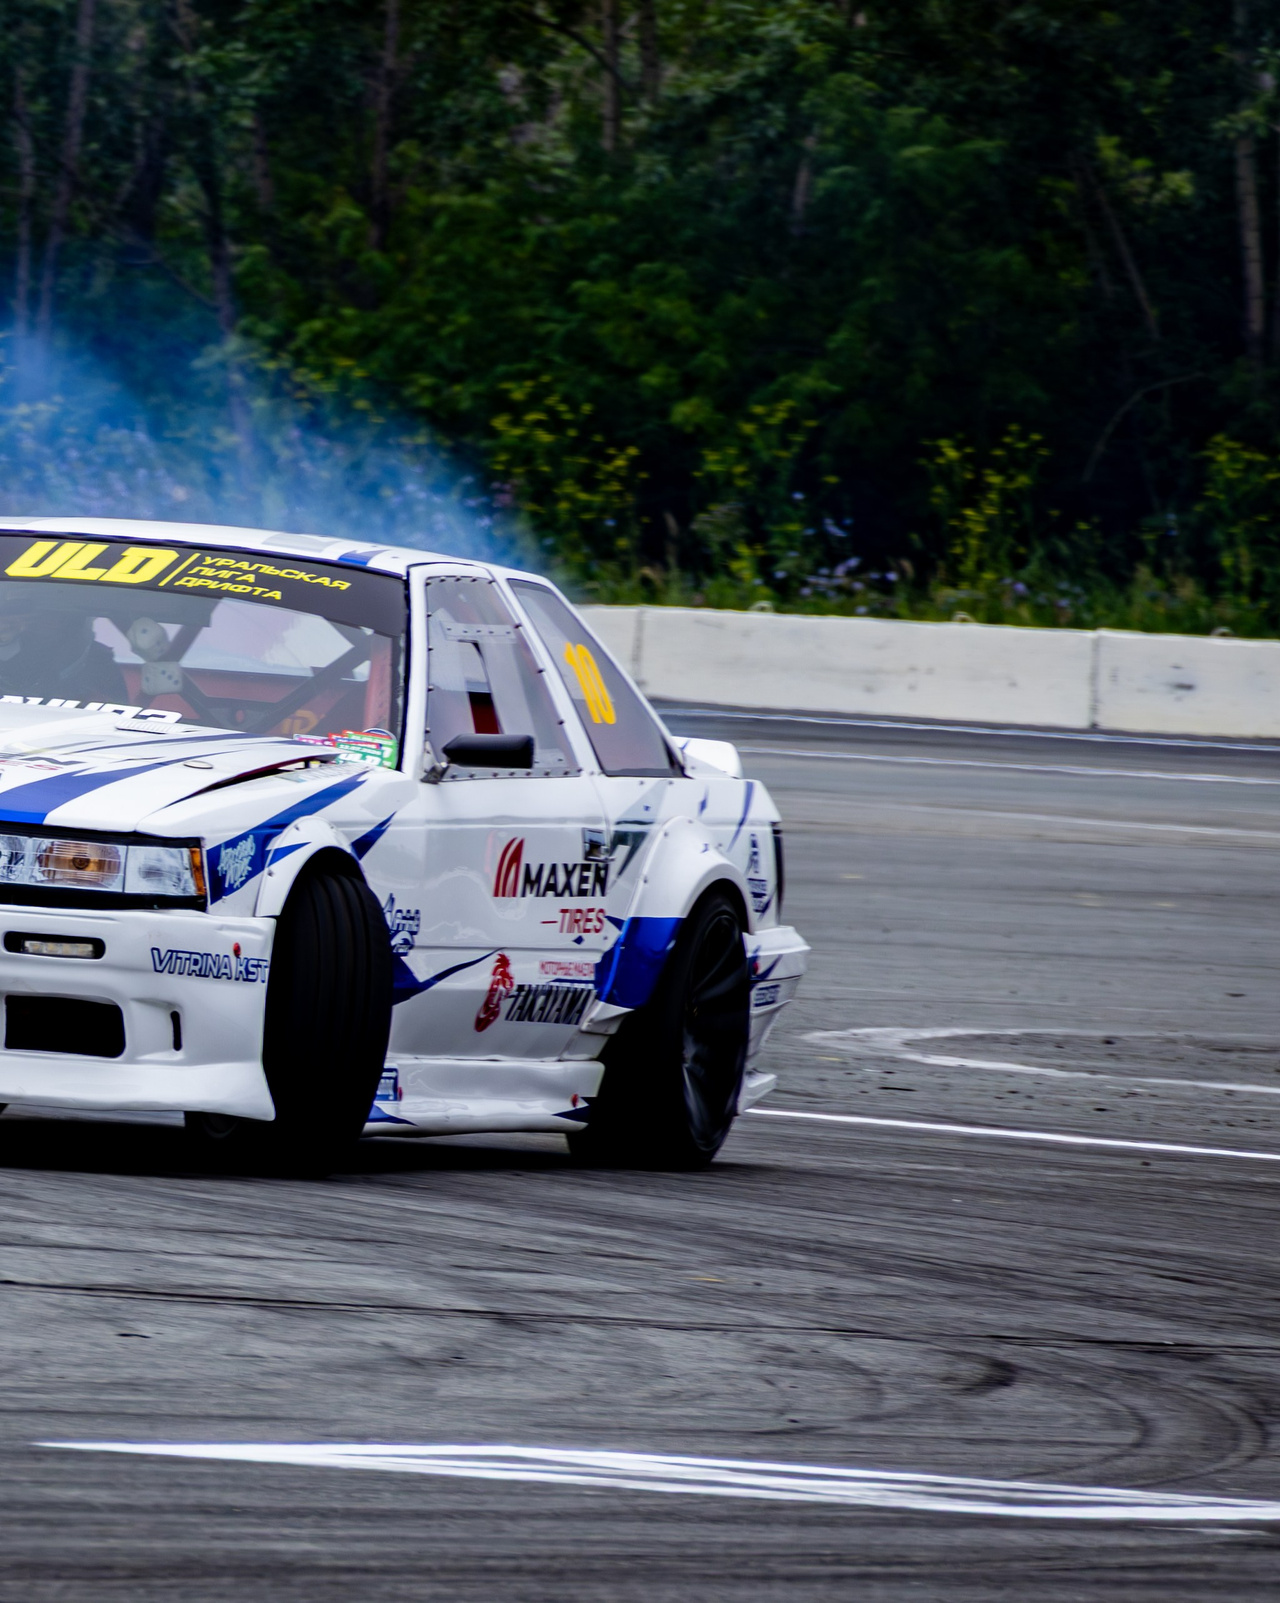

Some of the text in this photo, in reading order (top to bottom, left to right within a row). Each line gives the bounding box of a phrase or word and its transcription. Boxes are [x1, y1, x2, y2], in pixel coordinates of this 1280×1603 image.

[4, 540, 180, 584] ULD
[187, 566, 256, 583] ЛИГА
[202, 556, 352, 591] УРАЛЬСКАЯ
[174, 576, 283, 600] ДРИФТА
[520, 863, 610, 897] MAXEN
[558, 907, 607, 934] TIRES
[150, 946, 269, 984] VITRINA KST
